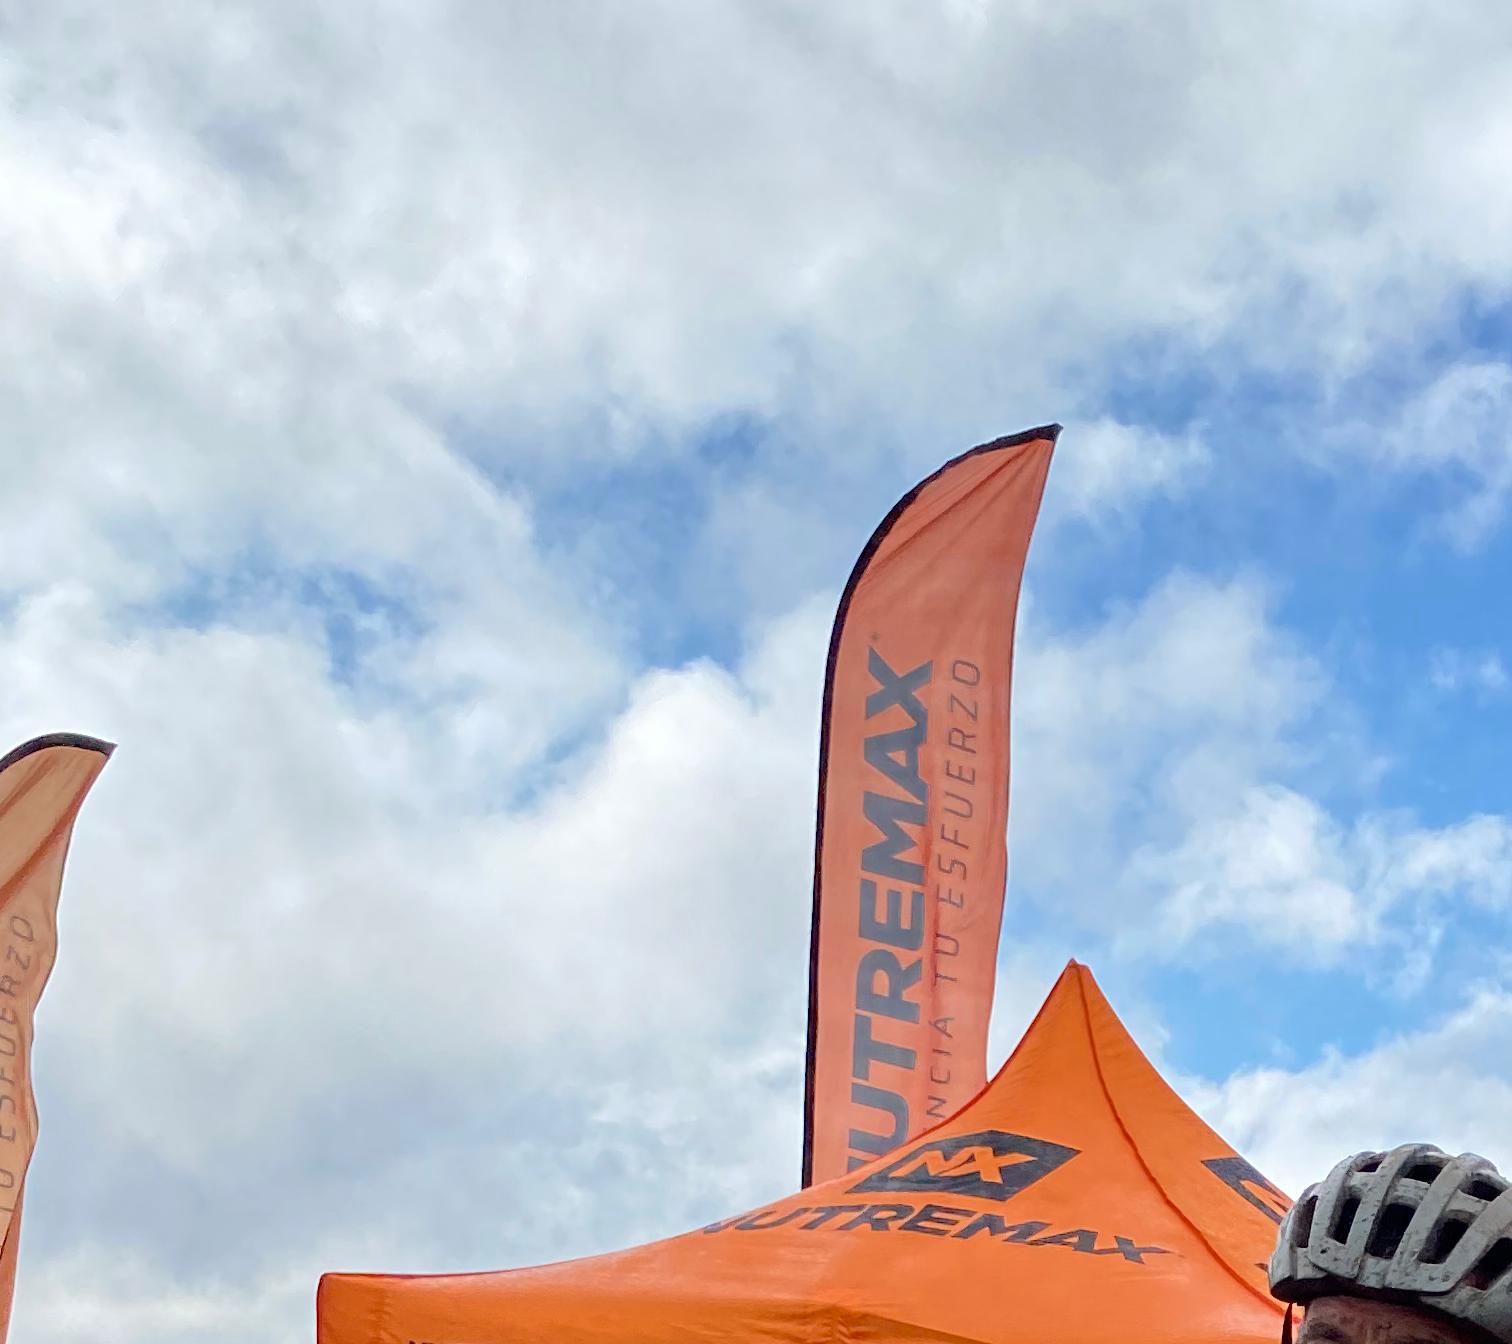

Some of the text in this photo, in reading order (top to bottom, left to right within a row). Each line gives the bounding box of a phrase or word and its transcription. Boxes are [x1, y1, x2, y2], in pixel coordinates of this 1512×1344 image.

[848, 646, 933, 1172] UTREMAX
[937, 659, 982, 910] ESFUERZO
[932, 932, 960, 987] TU
